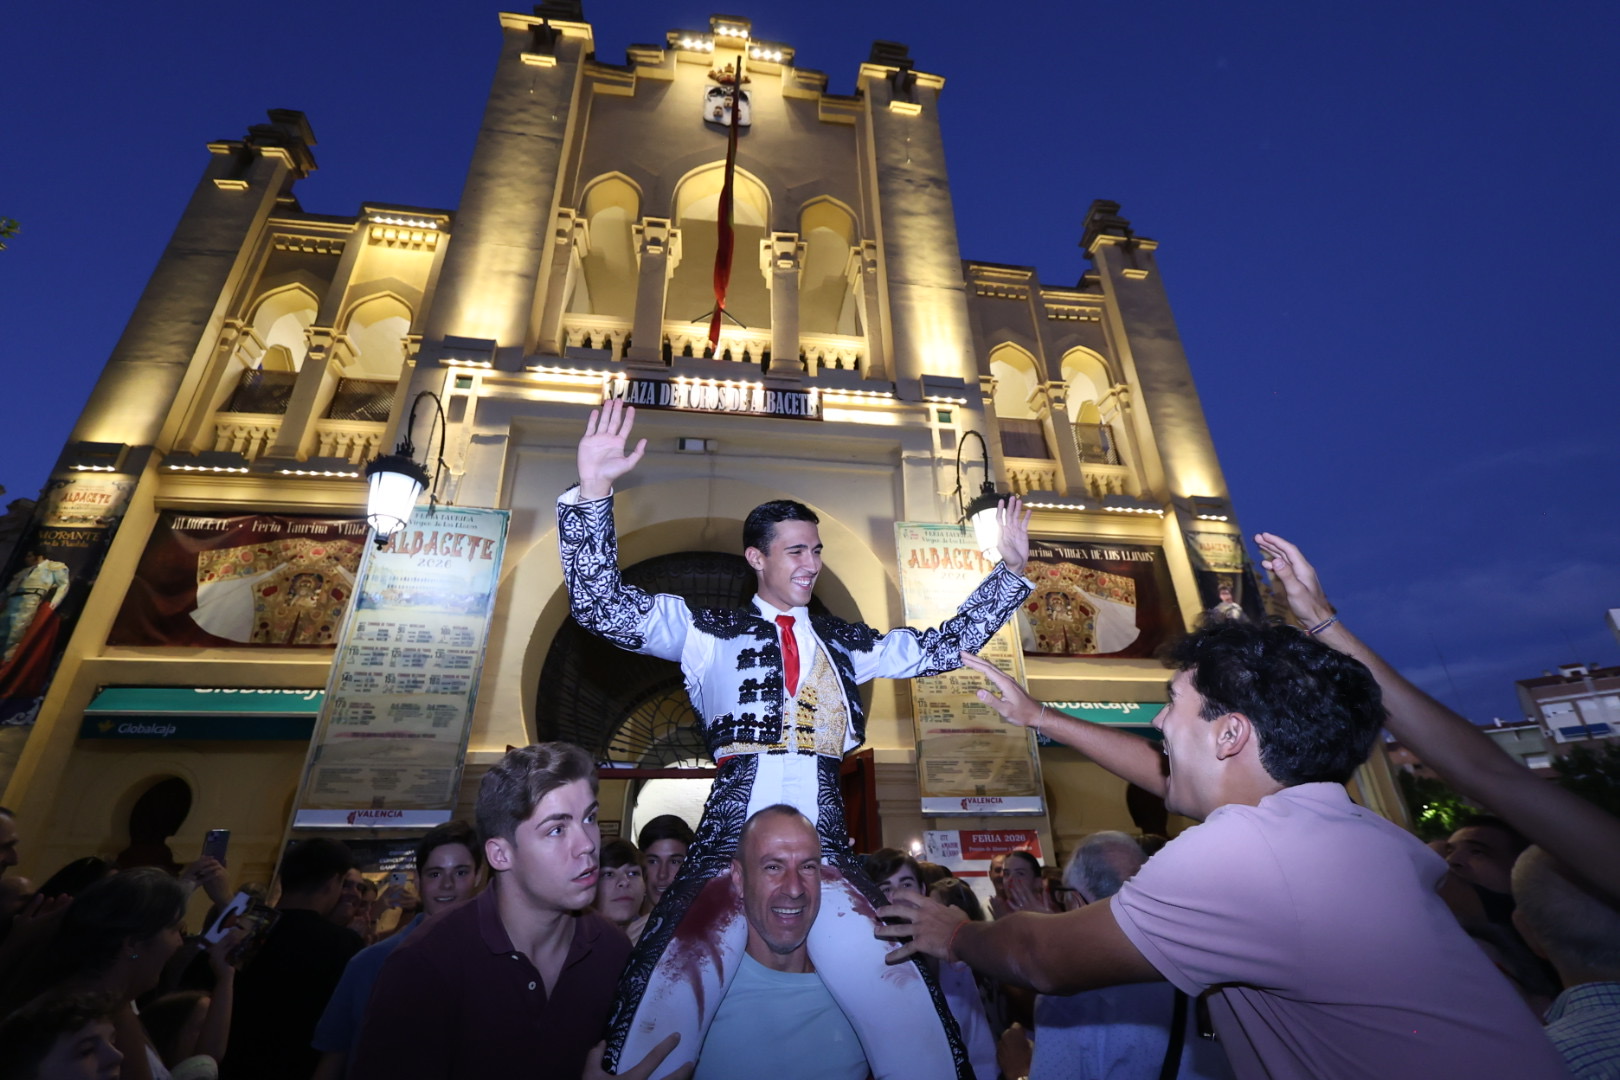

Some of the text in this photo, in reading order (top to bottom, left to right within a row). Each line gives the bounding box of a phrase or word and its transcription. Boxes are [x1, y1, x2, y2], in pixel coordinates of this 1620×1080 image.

[613, 379, 656, 405] PLAZA
[659, 382, 679, 407] DE
[680, 383, 727, 410] TOROS
[287, 521, 328, 535] Taurina
[382, 530, 495, 562] ALBACETE
[118, 723, 176, 737] Globalcaja
[969, 797, 1004, 805] VALENCIA
[357, 810, 403, 818] VALENCIA
[972, 834, 1002, 843] FERIA
